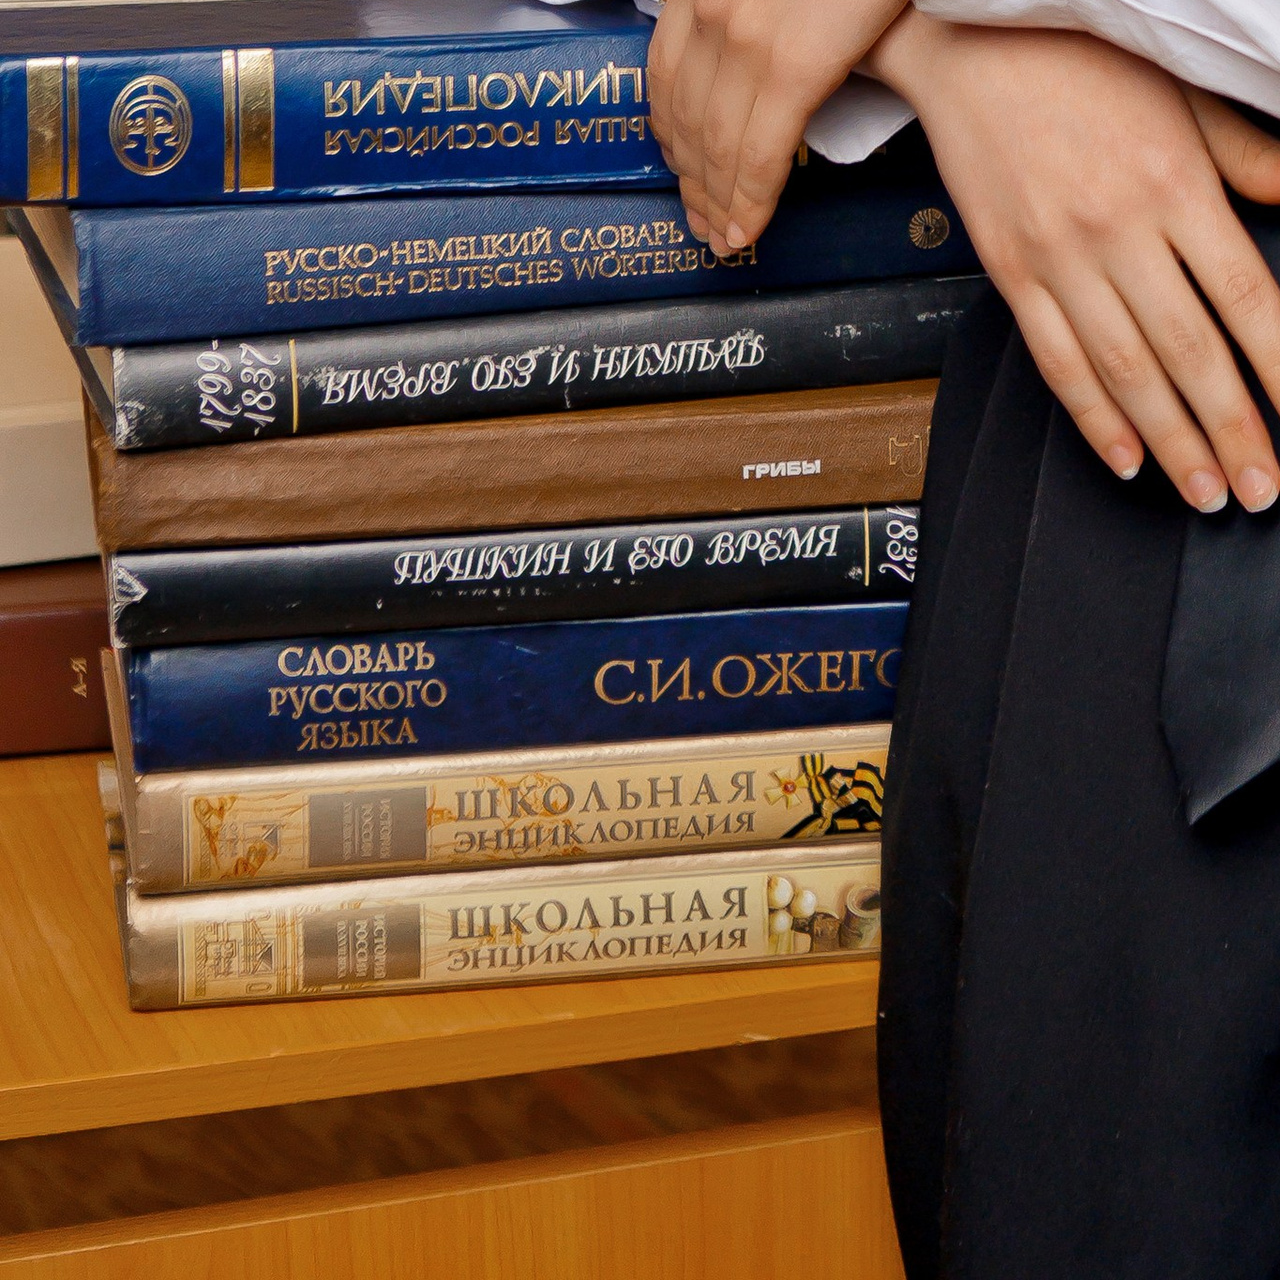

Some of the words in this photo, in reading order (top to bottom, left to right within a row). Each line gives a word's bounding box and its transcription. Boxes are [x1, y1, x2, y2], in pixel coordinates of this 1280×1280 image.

[323, 60, 650, 118] ЦИКЛОПЕДИЯ
[324, 119, 540, 157] РОССИЙСКАЯ
[555, 114, 650, 145] ЬШАЯ
[264, 225, 552, 276] РУССКО-НЕМЕЦКИЙ
[560, 220, 685, 254] СЛОВАРЬ
[265, 259, 564, 305] RUSSISCH-DEUTSCHES
[470, 353, 537, 392] ЕГО
[547, 346, 581, 385] И
[591, 333, 766, 381] ПУШКИН
[196, 339, 242, 434] 1799-
[239, 342, 283, 436] -1837
[321, 359, 459, 406] ВРЕМЯ
[741, 459, 821, 480] ГРИБЫ
[393, 540, 575, 586] ПУШКИН
[583, 538, 618, 573] И
[628, 532, 694, 576] ЕГО
[704, 524, 841, 567] ВРЕМЯ
[277, 640, 436, 678] СЛОВАРЬ
[268, 678, 448, 720] РУССКОГО
[296, 716, 419, 752] ЯЗЫКА
[454, 770, 757, 822] ШКОЛЬНАЯ
[453, 810, 756, 854] ЭНЦИКЛОПЕДИЯ
[446, 886, 749, 940] ШКОЛЬНАЯ
[446, 927, 749, 972] ЭНЦИКЛОПЕДИЯ
